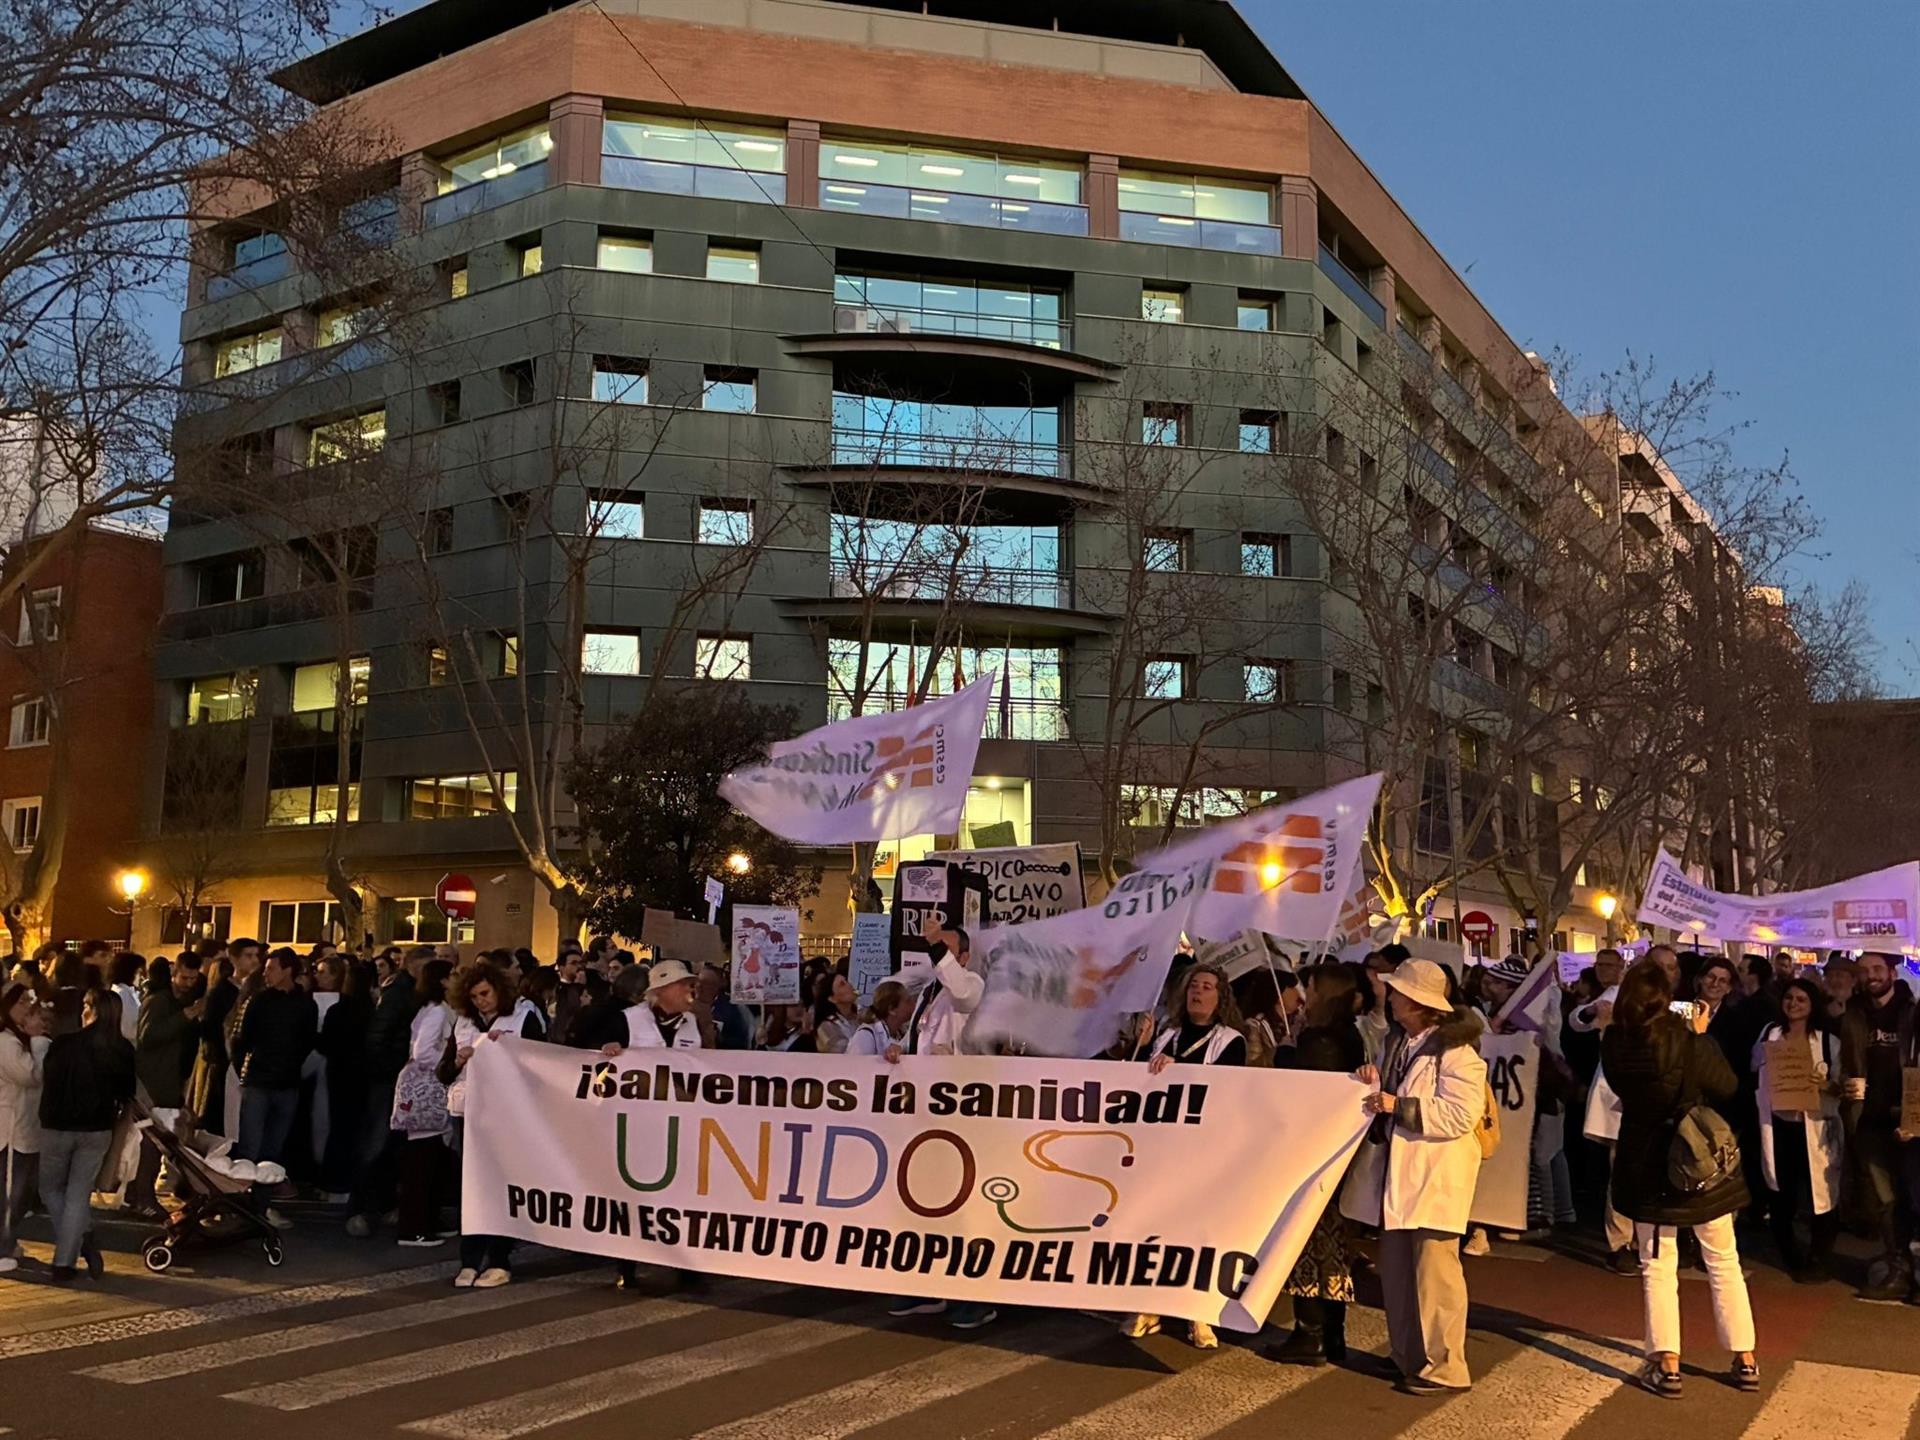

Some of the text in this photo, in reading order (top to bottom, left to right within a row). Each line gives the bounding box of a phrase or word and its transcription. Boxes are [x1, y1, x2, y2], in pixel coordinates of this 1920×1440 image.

[950, 856, 1024, 880] ÉDICO
[985, 883, 1062, 902] SCLAVO
[1008, 904, 1040, 925] 24
[576, 1062, 1208, 1125] ¡Salvemos la sanidad!
[616, 1112, 1134, 1234] UNIDOS
[507, 1184, 1259, 1301] POR UN ESTATUTO PROPIO DEL MÉDIC
